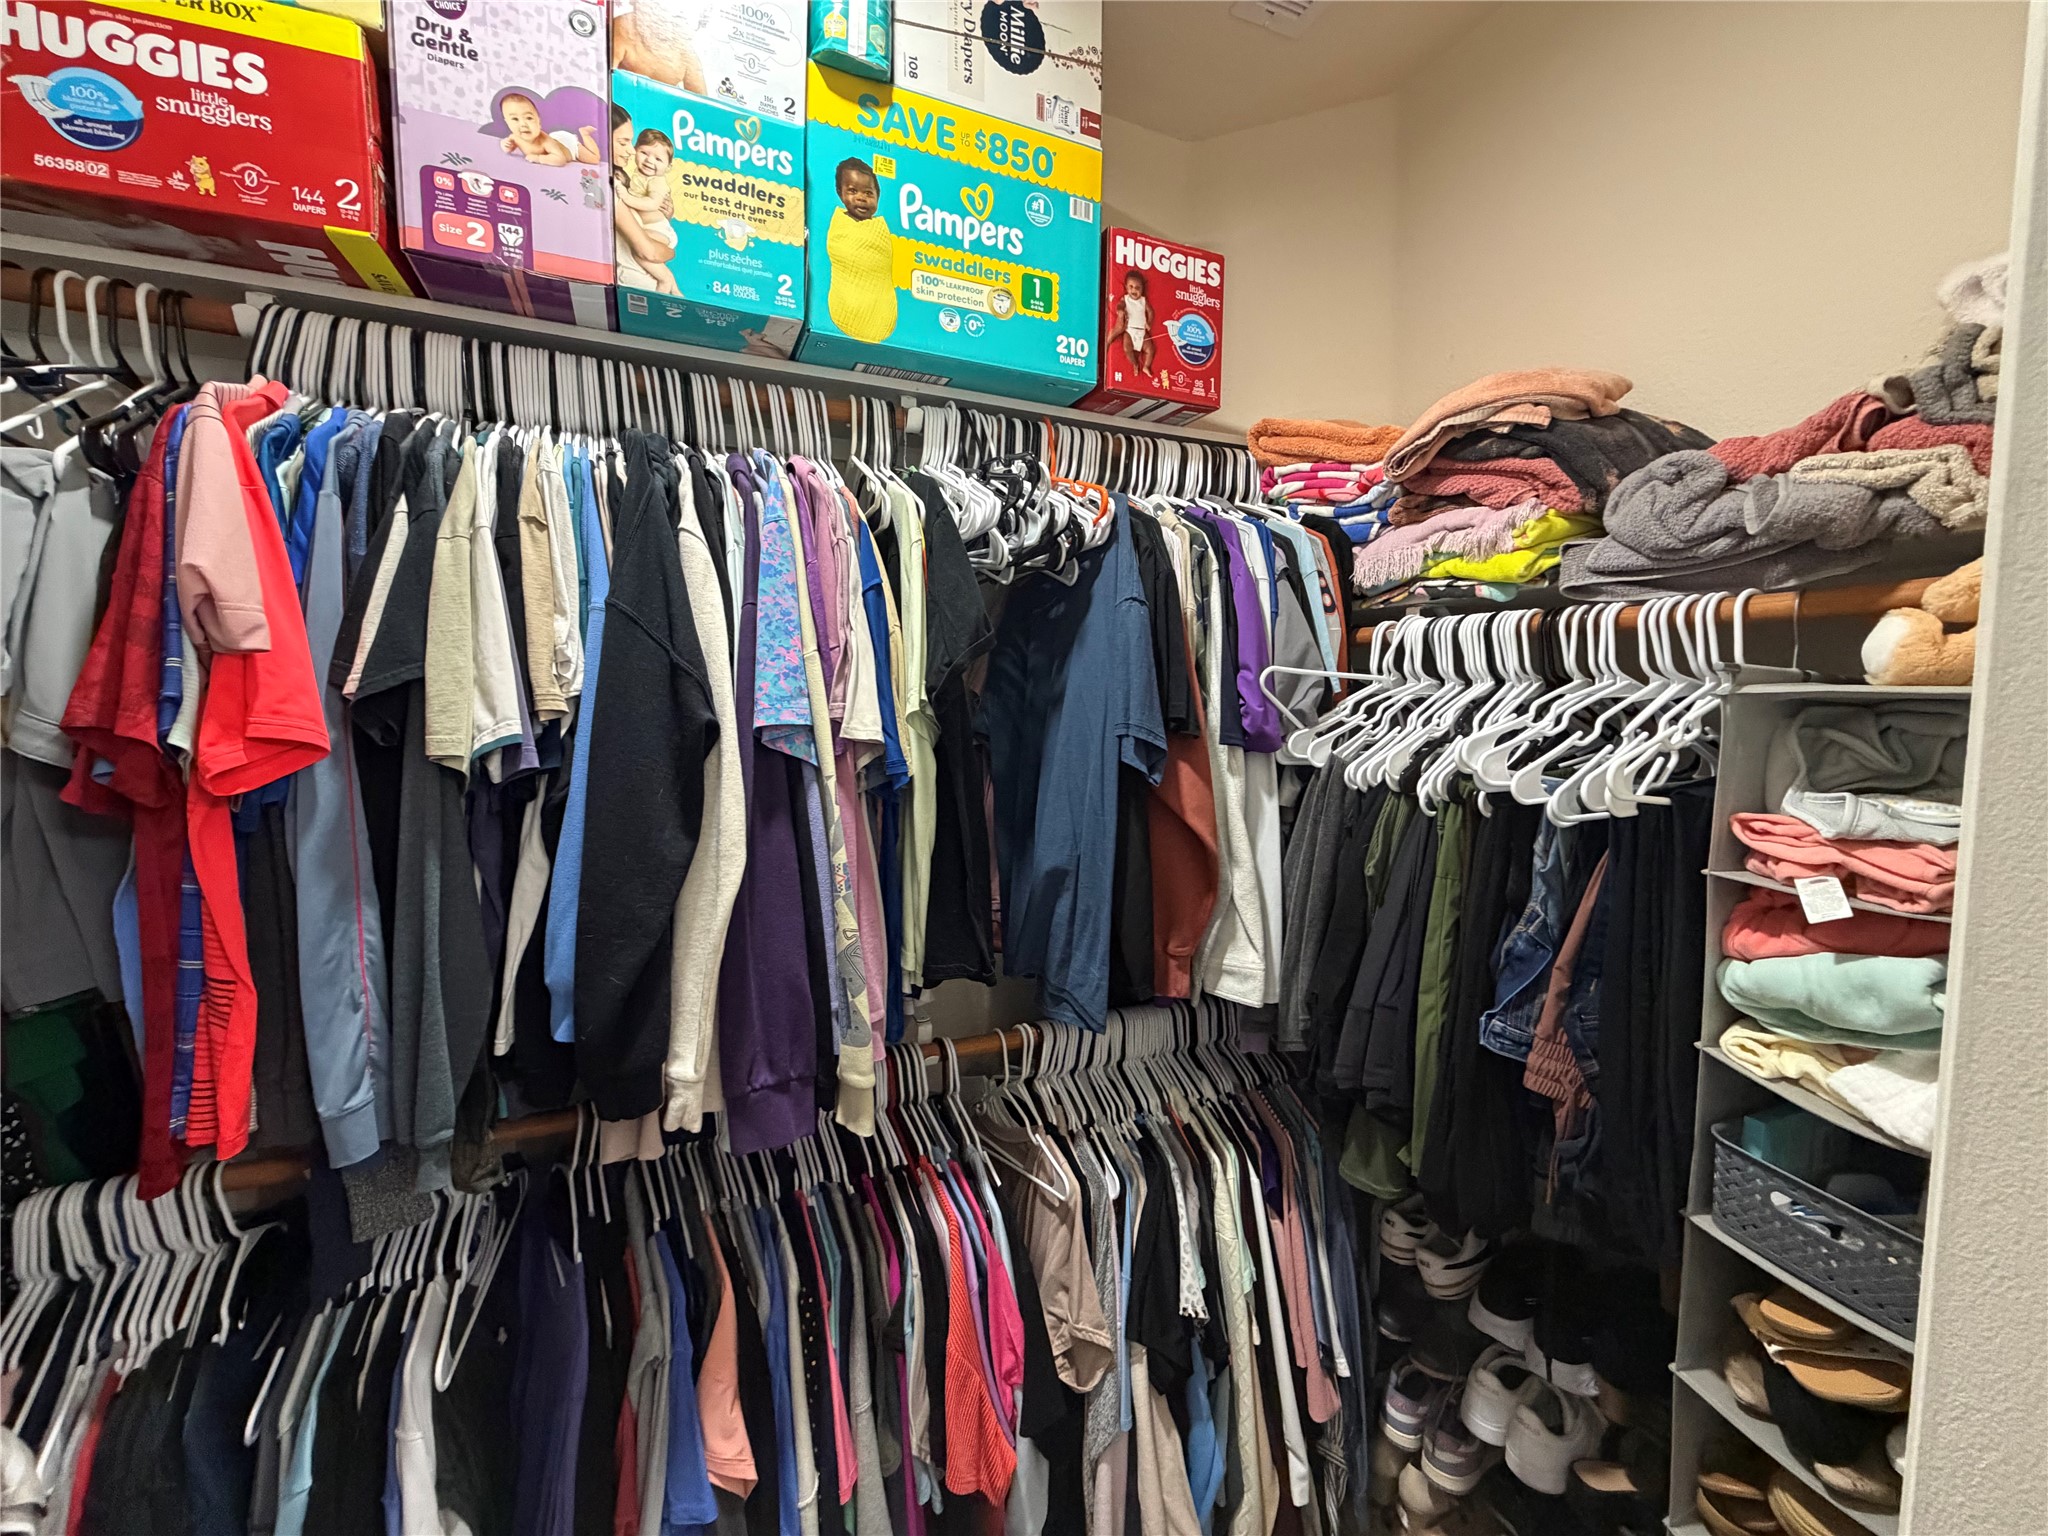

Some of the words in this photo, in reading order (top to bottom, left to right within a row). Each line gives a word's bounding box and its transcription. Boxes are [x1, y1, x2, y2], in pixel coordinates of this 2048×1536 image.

[741, 4, 775, 26] 100%
[416, 15, 453, 41] Dry
[459, 28, 473, 44] &
[1000, 10, 1009, 52] MOON
[1010, 5, 1026, 65] Millie
[0, 0, 268, 95] HUGGIES
[411, 32, 479, 61] Gentle
[427, 53, 464, 69] Diapers
[908, 55, 919, 80] 108
[190, 87, 229, 108] little
[784, 97, 796, 116] 2
[156, 96, 273, 131] snugglers
[857, 93, 956, 152] SAVE
[672, 109, 794, 177] Pampers
[960, 131, 971, 140] UP
[960, 138, 971, 148] TO
[435, 175, 453, 187] 0%
[682, 173, 786, 209] swaddlers
[291, 185, 326, 205] 144
[334, 178, 362, 212] 2
[683, 191, 699, 201] our
[701, 191, 731, 207] best
[734, 200, 785, 220] dryness
[292, 202, 327, 216] DIAPERS
[709, 206, 746, 220] comfort
[748, 214, 767, 225] ever
[1031, 198, 1045, 215] #1
[438, 223, 463, 236] Size
[900, 182, 1024, 256] Pampers
[466, 221, 487, 248] 2
[500, 225, 521, 237] 144
[708, 248, 730, 261] plus
[730, 252, 763, 269] sèches
[914, 251, 1012, 284] swaddlers
[1115, 235, 1221, 287] HUGGIES
[712, 280, 732, 296] 84
[777, 274, 793, 297] 2
[920, 274, 945, 288] 100%
[945, 281, 985, 296] LEAKPROOF
[1032, 278, 1041, 299] 1
[1189, 284, 1204, 295] little
[916, 286, 935, 297] skin
[937, 291, 985, 308] protection
[1175, 289, 1221, 309] snugglers
[1056, 334, 1089, 358] 210
[1059, 354, 1086, 368] DIAPERS
[1209, 377, 1216, 393] 1
